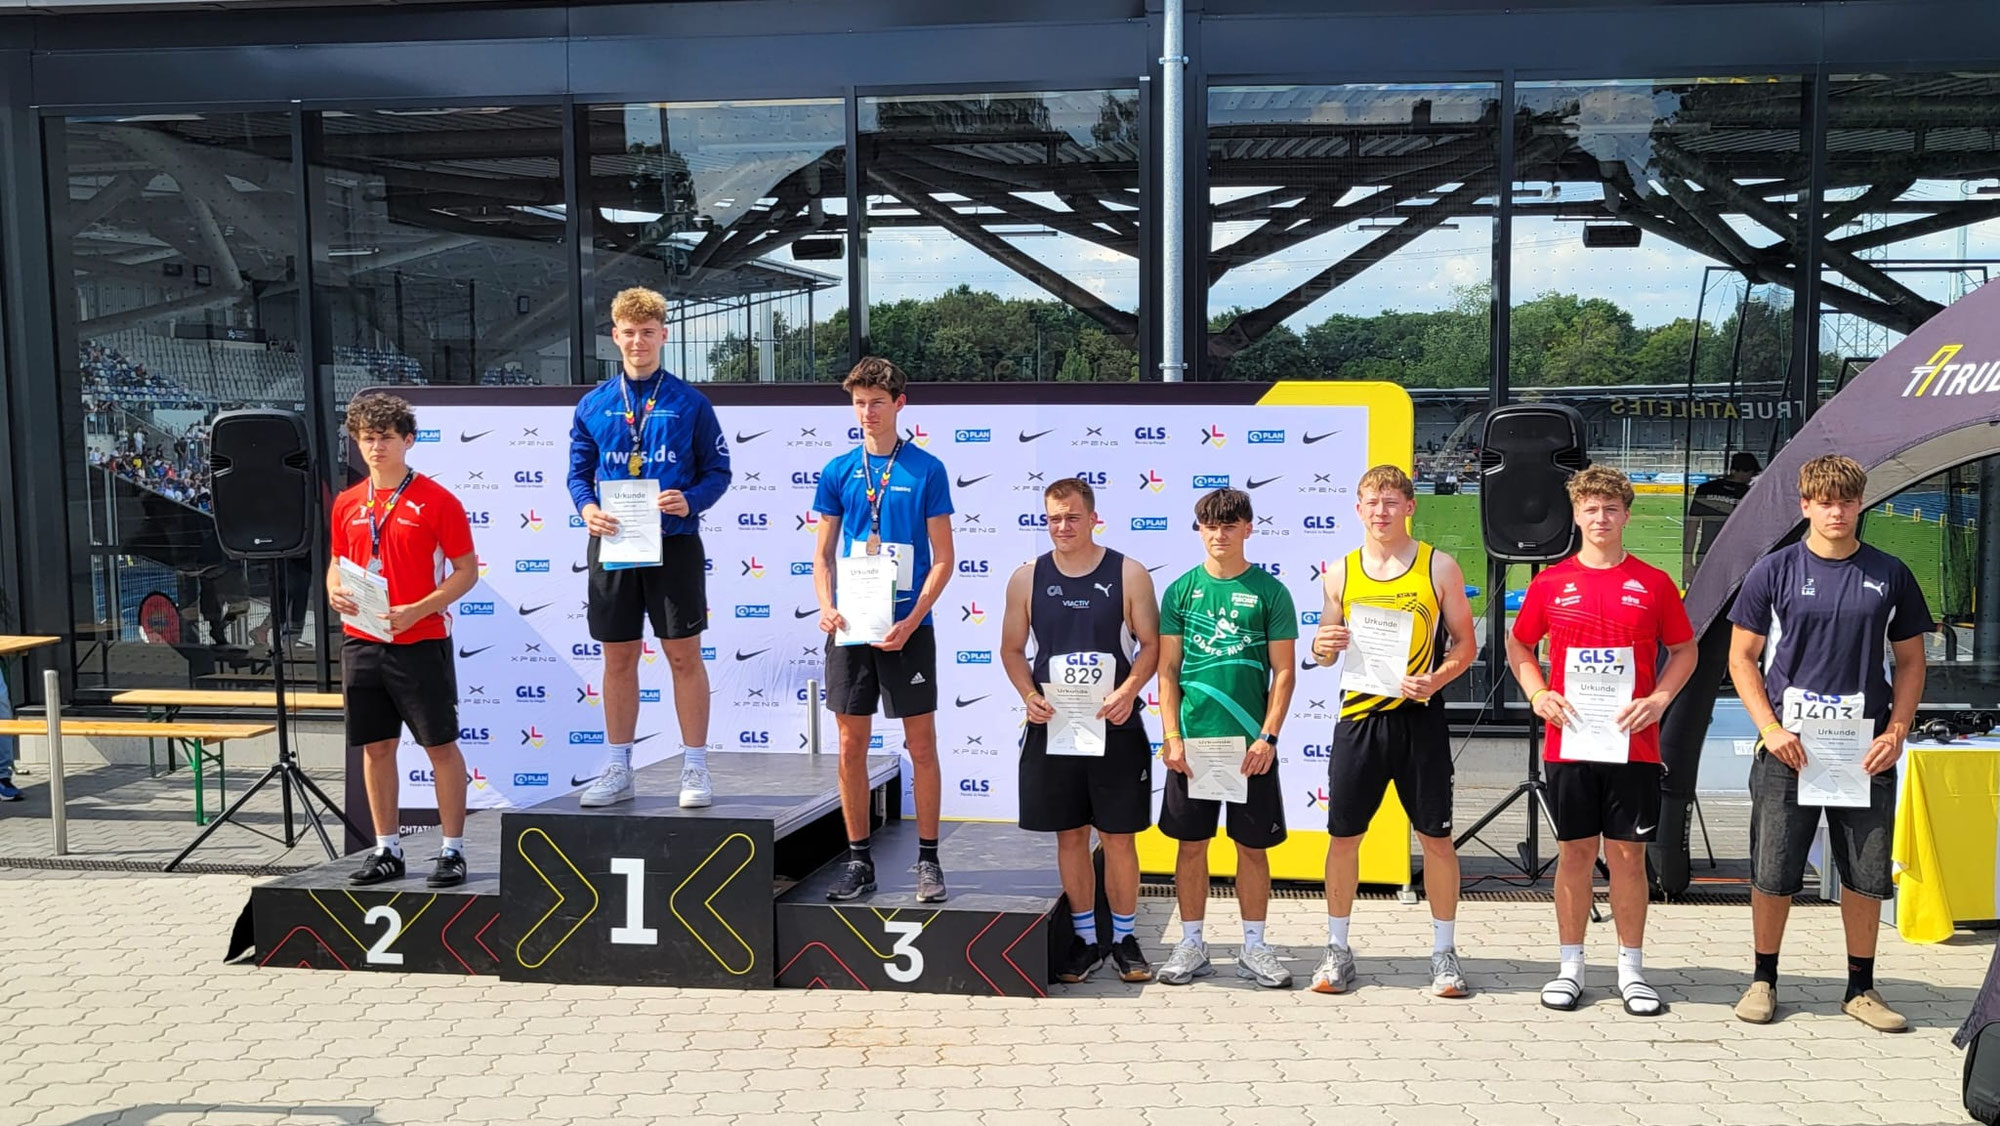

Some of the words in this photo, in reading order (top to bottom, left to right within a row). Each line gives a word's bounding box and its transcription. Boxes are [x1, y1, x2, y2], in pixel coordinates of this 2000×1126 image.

[848, 427, 864, 440] GL
[792, 472, 820, 484] GLS
[1018, 514, 1048, 526] GLS
[1364, 616, 1398, 628] Urkunde
[572, 644, 602, 656] GLS
[1064, 668, 1102, 684] 829
[1580, 684, 1616, 692] Urkunde
[1794, 702, 1852, 720] 1403
[610, 858, 658, 944] 1
[364, 905, 404, 965] 2
[884, 921, 923, 982] 3
